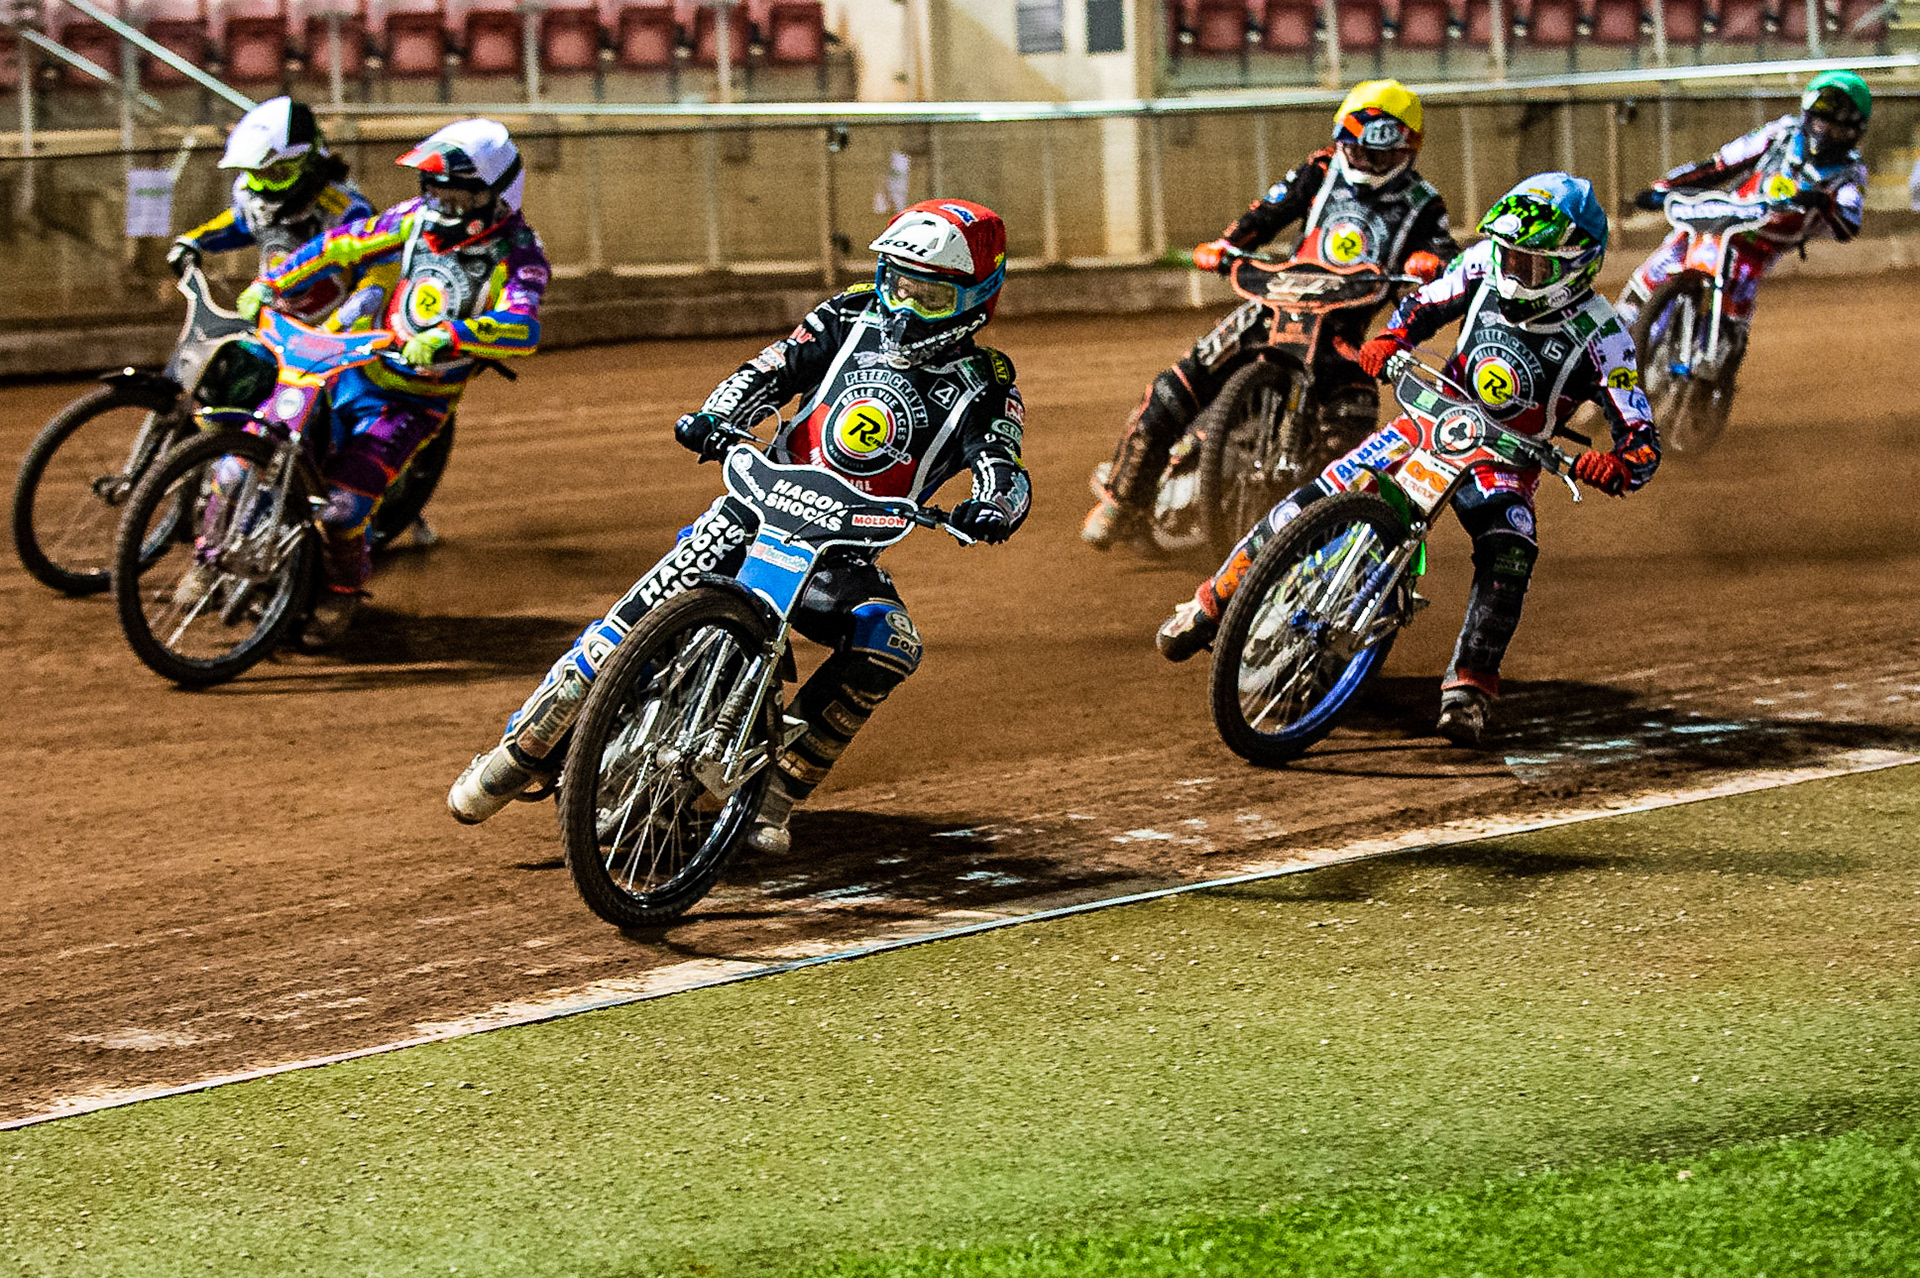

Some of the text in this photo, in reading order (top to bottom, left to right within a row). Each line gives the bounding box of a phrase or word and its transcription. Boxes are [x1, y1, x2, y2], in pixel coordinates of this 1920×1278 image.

[1543, 339, 1565, 361] 15
[841, 388, 907, 440] BELLE VUE ACES
[844, 369, 929, 428] PETER CRAVEN
[934, 386, 955, 405] 4
[764, 492, 843, 532] SHOCKS
[772, 479, 848, 518] HAGON
[638, 513, 731, 607] HAGON
